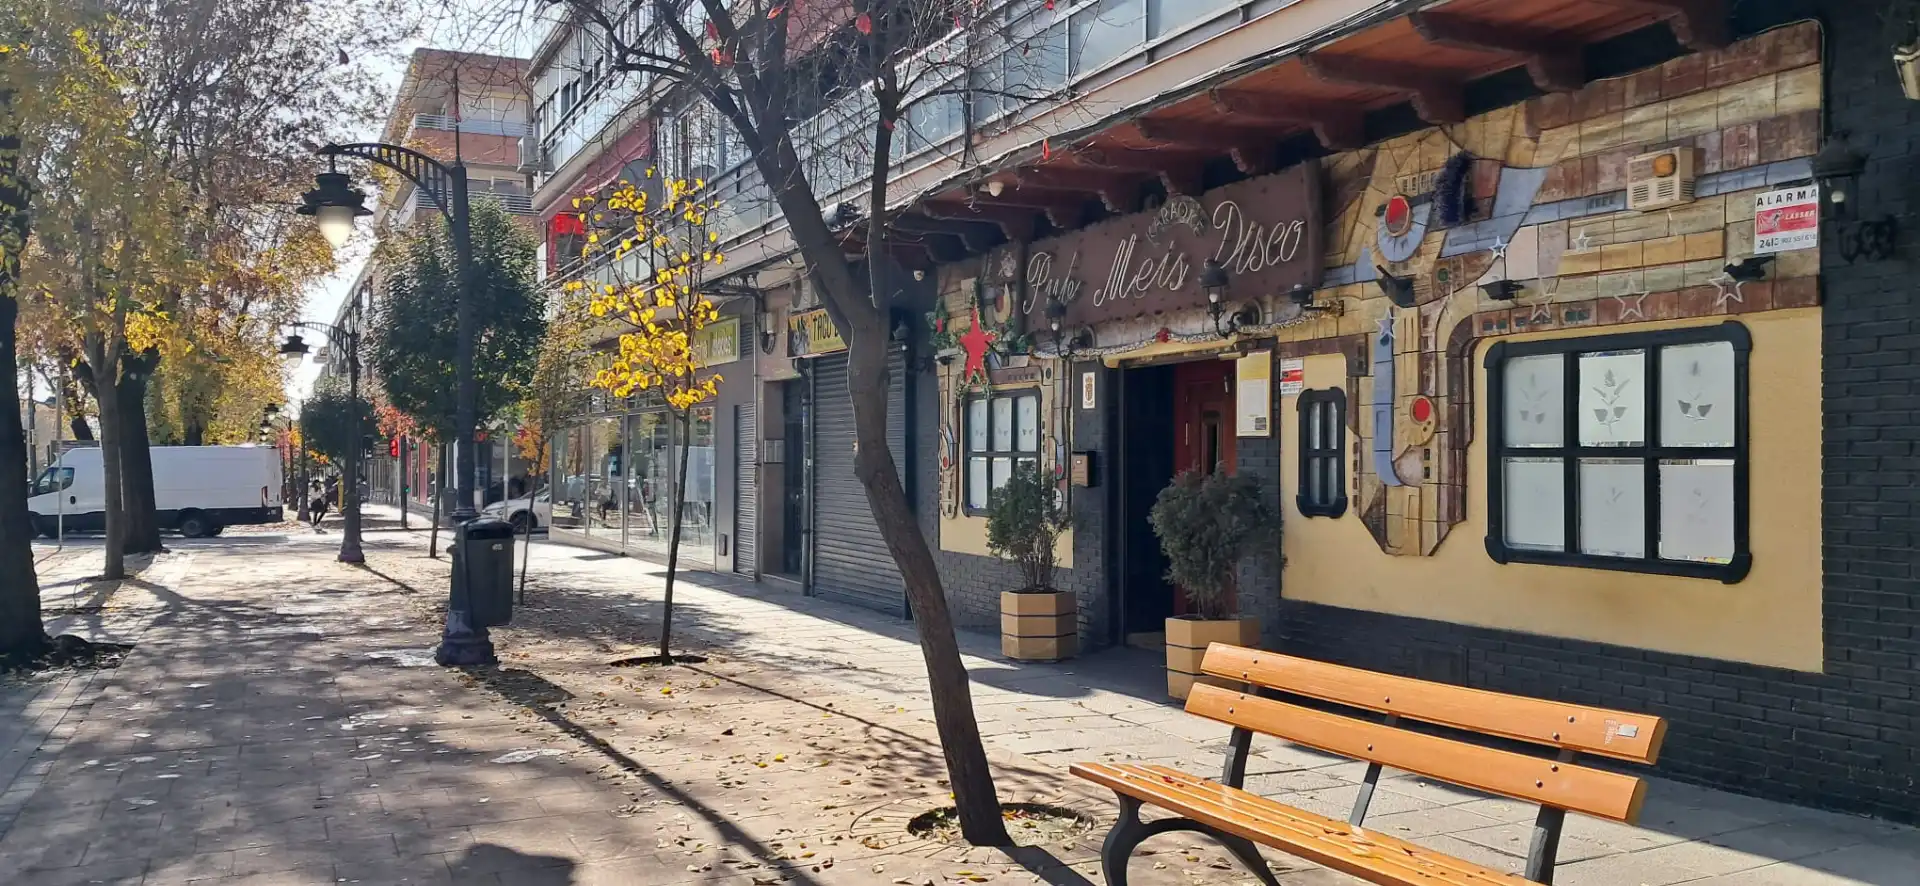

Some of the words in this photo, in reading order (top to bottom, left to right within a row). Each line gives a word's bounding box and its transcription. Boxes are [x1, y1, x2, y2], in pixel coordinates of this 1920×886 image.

[1756, 189, 1817, 207] ALARMA
[1146, 201, 1205, 248] KARAOKE
[1093, 232, 1190, 308] Meis
[1213, 200, 1305, 275] Disco
[812, 313, 832, 342] TACO
